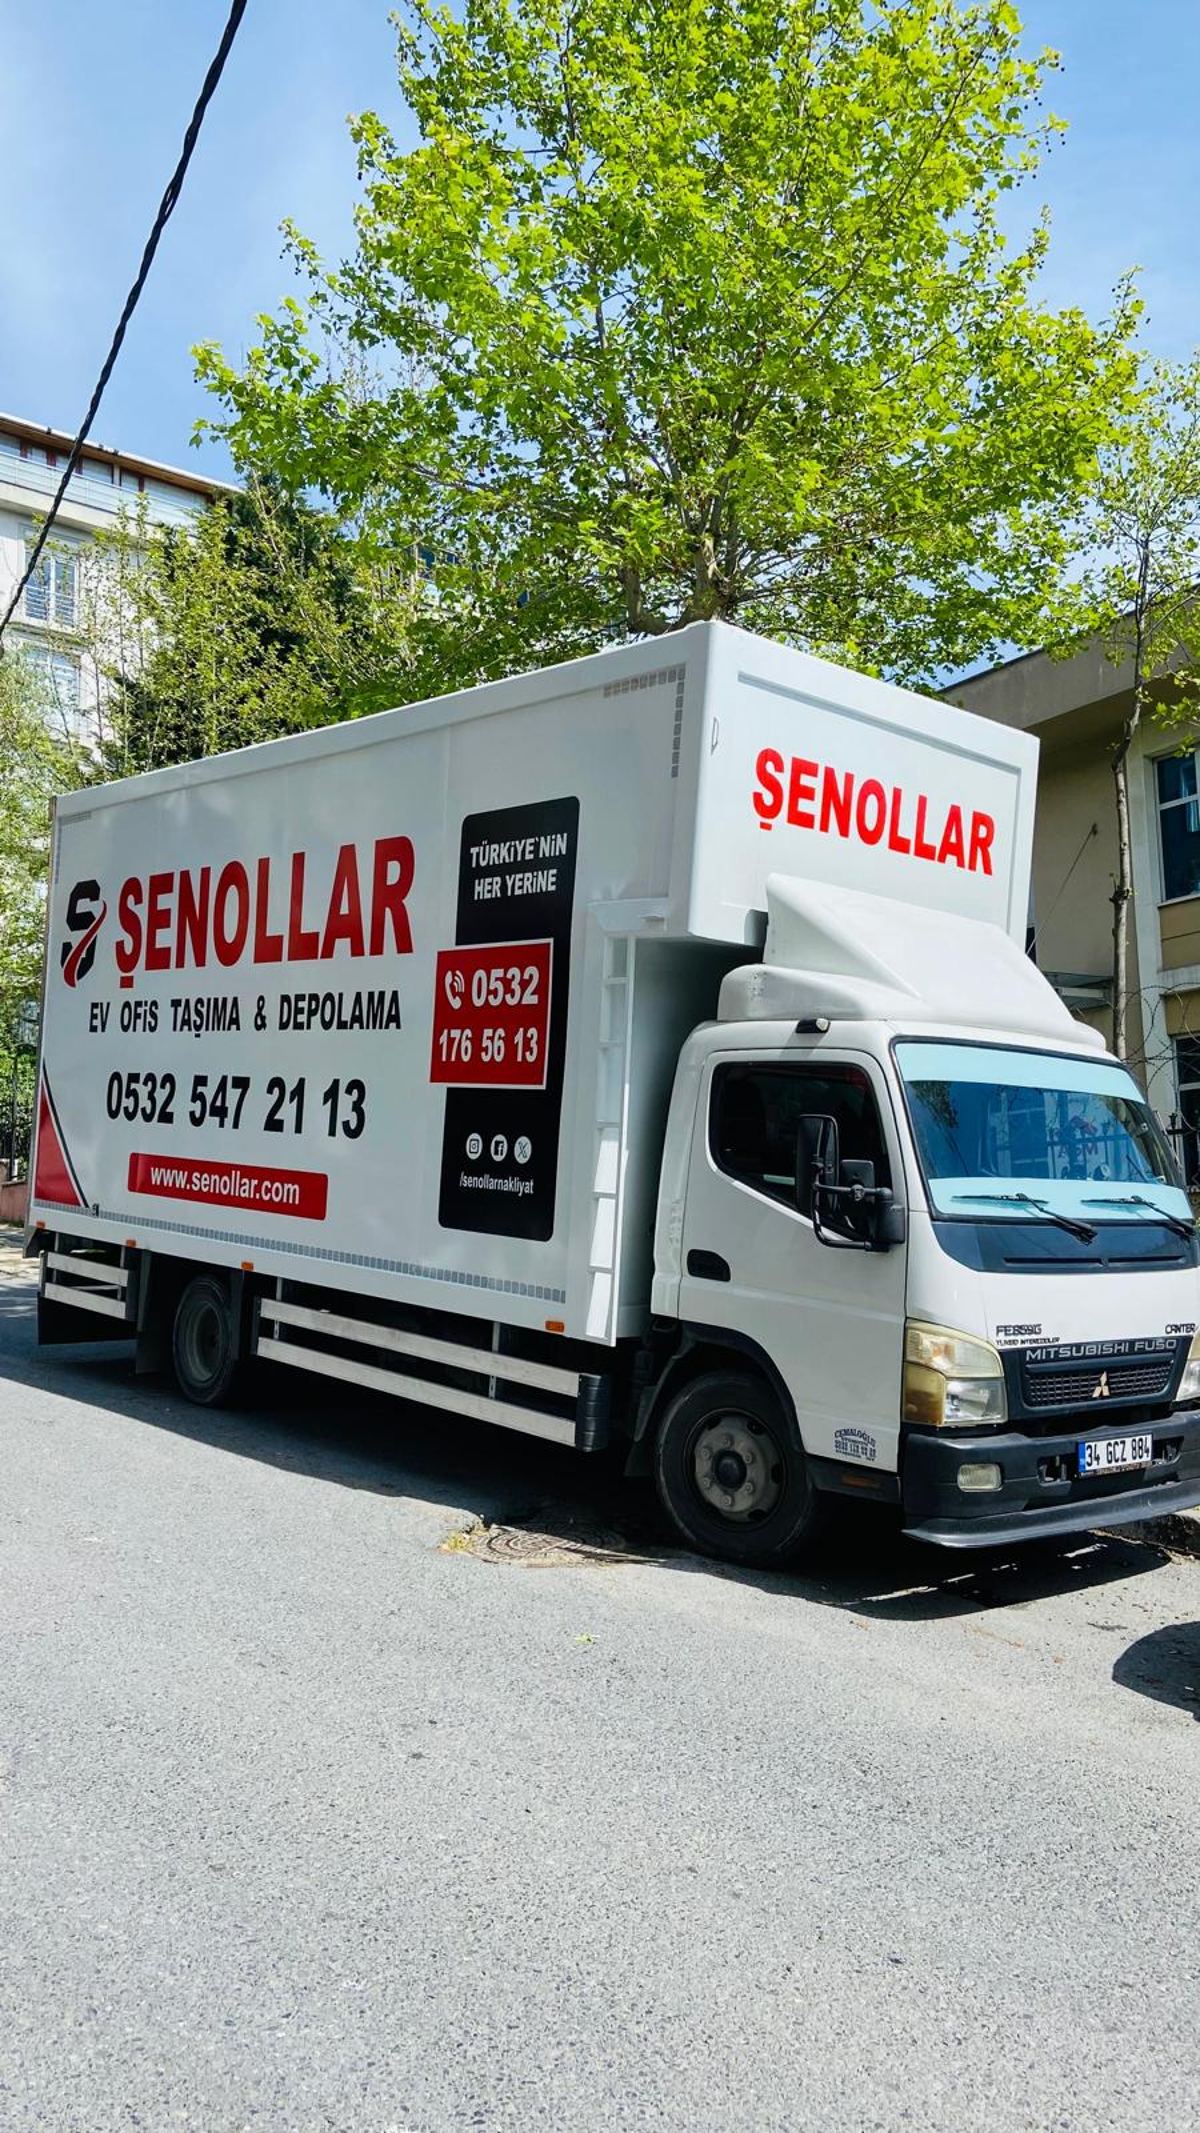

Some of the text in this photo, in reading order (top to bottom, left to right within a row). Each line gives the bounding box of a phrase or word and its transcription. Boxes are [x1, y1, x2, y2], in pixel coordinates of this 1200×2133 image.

[753, 748, 995, 876] ŞENOLLAR
[474, 876, 502, 900] HER
[115, 836, 415, 988] ŞENOLLAR
[472, 966, 540, 1007] 0532
[89, 1002, 110, 1032] EV
[171, 997, 241, 1038] TAŞIMA
[254, 995, 267, 1030] &
[278, 990, 401, 1031] DEPOLAMA
[439, 1027, 538, 1062] 176 56 13
[106, 1071, 366, 1139] 0532 547 21 13
[150, 1166, 300, 1205] www.senollar.com
[1026, 1339, 1177, 1361] MITSUBISHI FUSO
[1086, 1436, 1150, 1467] 34 GCZ 884
